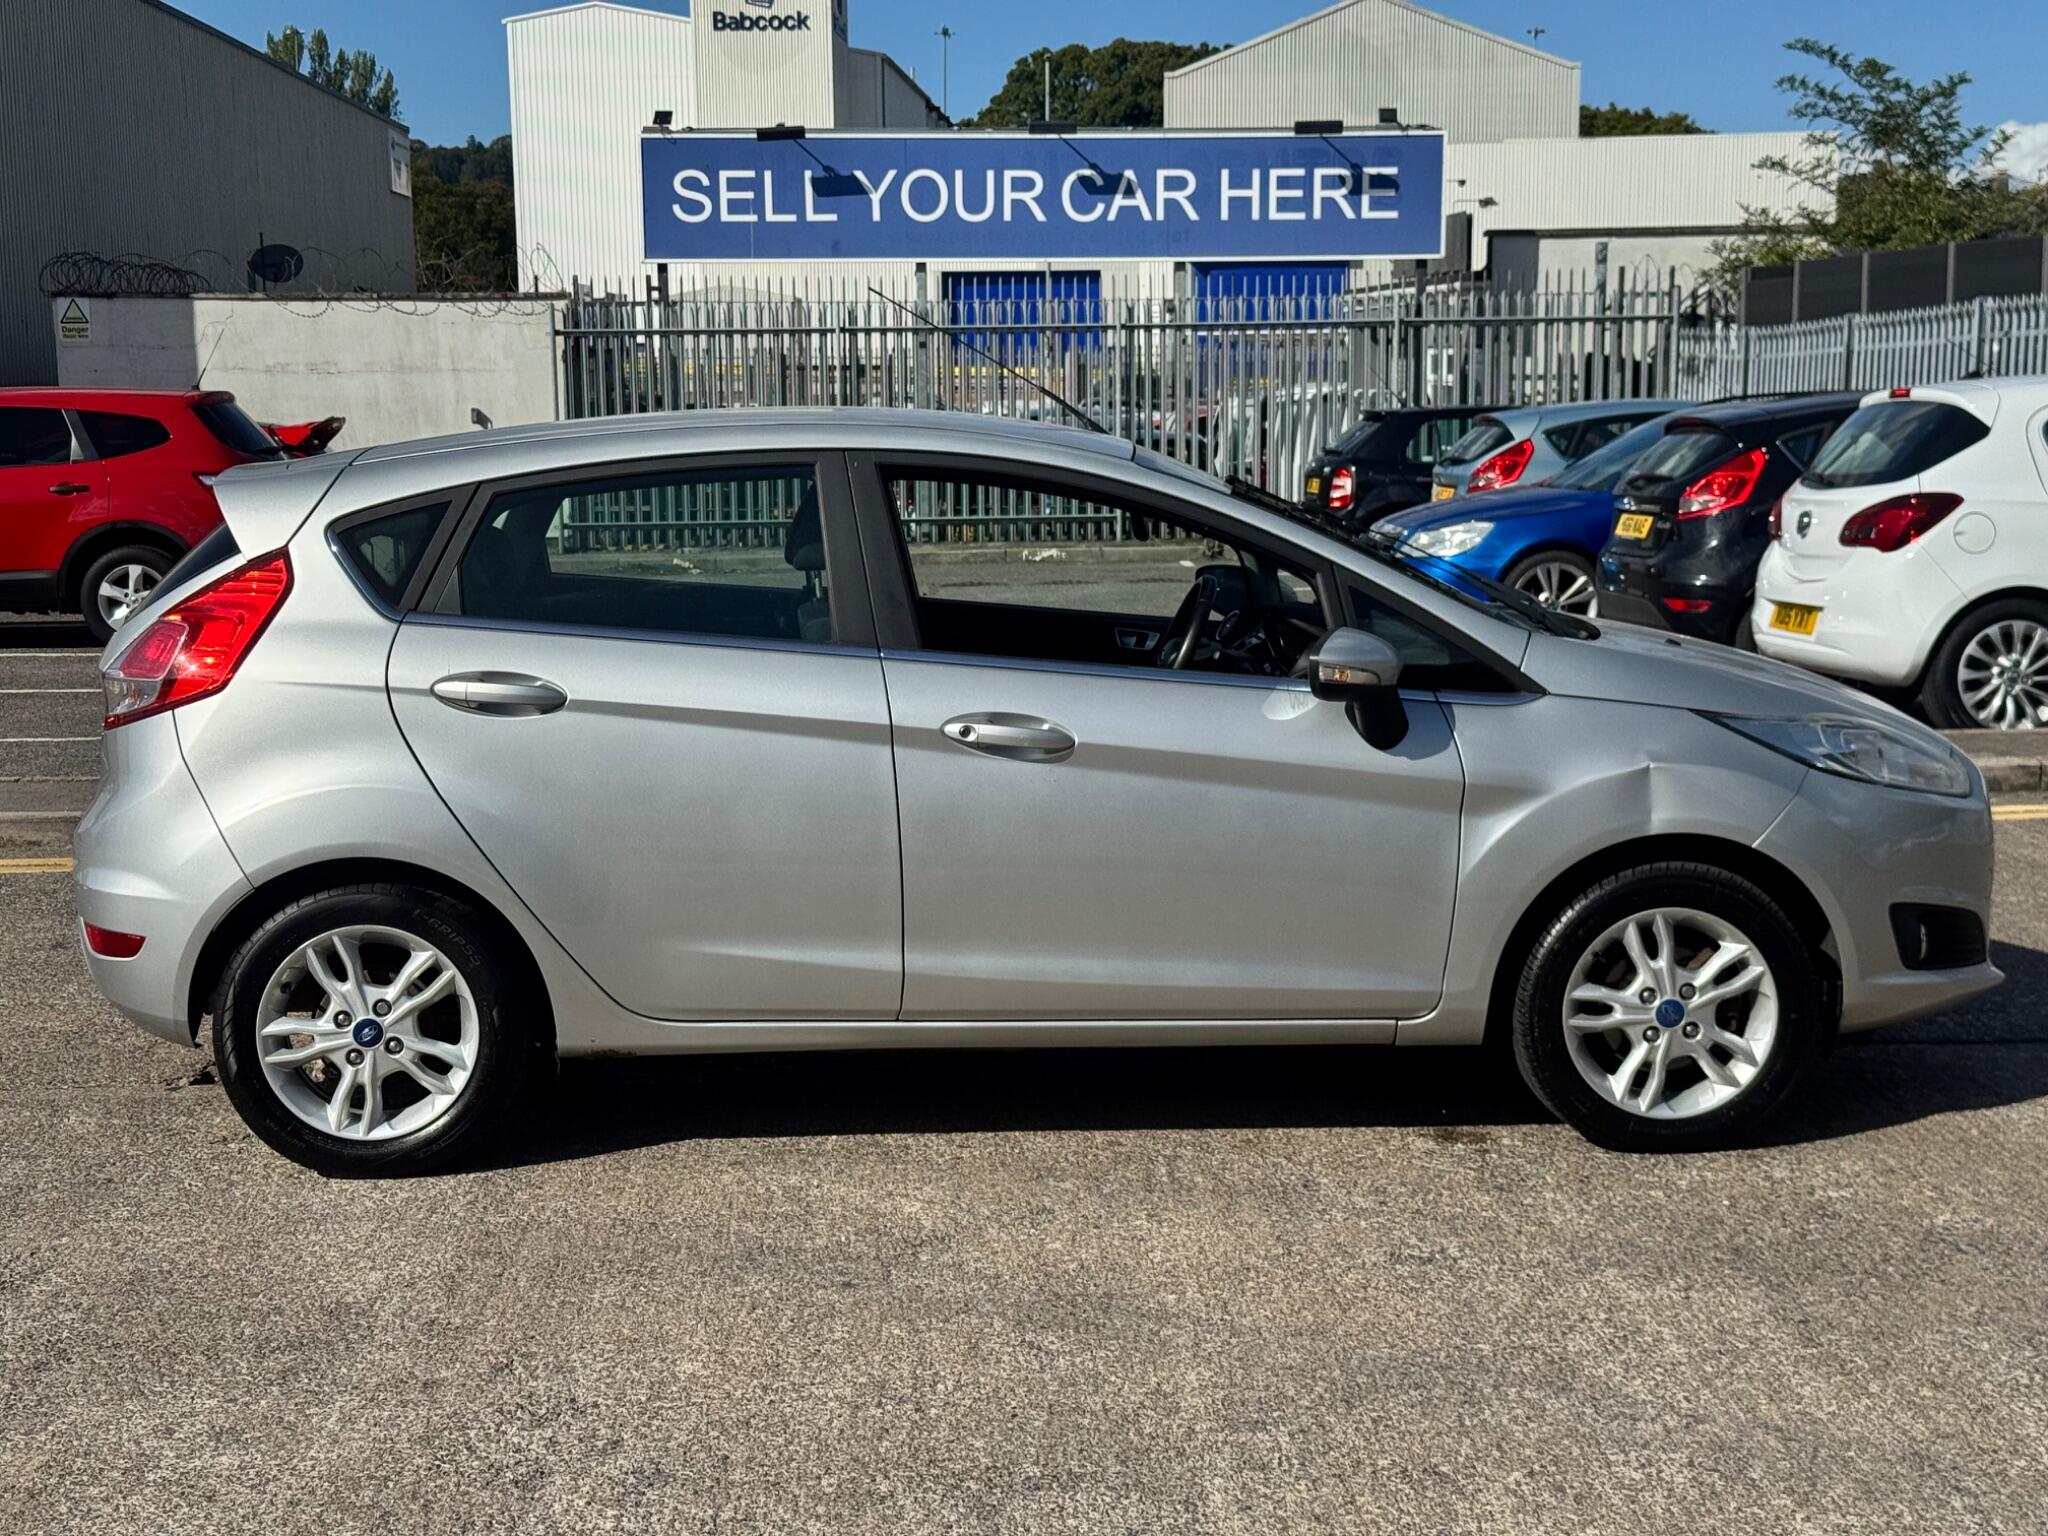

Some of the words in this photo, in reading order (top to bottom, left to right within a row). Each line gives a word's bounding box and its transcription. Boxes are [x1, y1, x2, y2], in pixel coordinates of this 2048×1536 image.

[712, 11, 811, 31] Babcock
[671, 168, 839, 223] SELL
[854, 168, 1048, 223] YOUR
[1061, 167, 1201, 222] CAR
[1220, 166, 1400, 221] HERE
[61, 326, 88, 334] Danger
